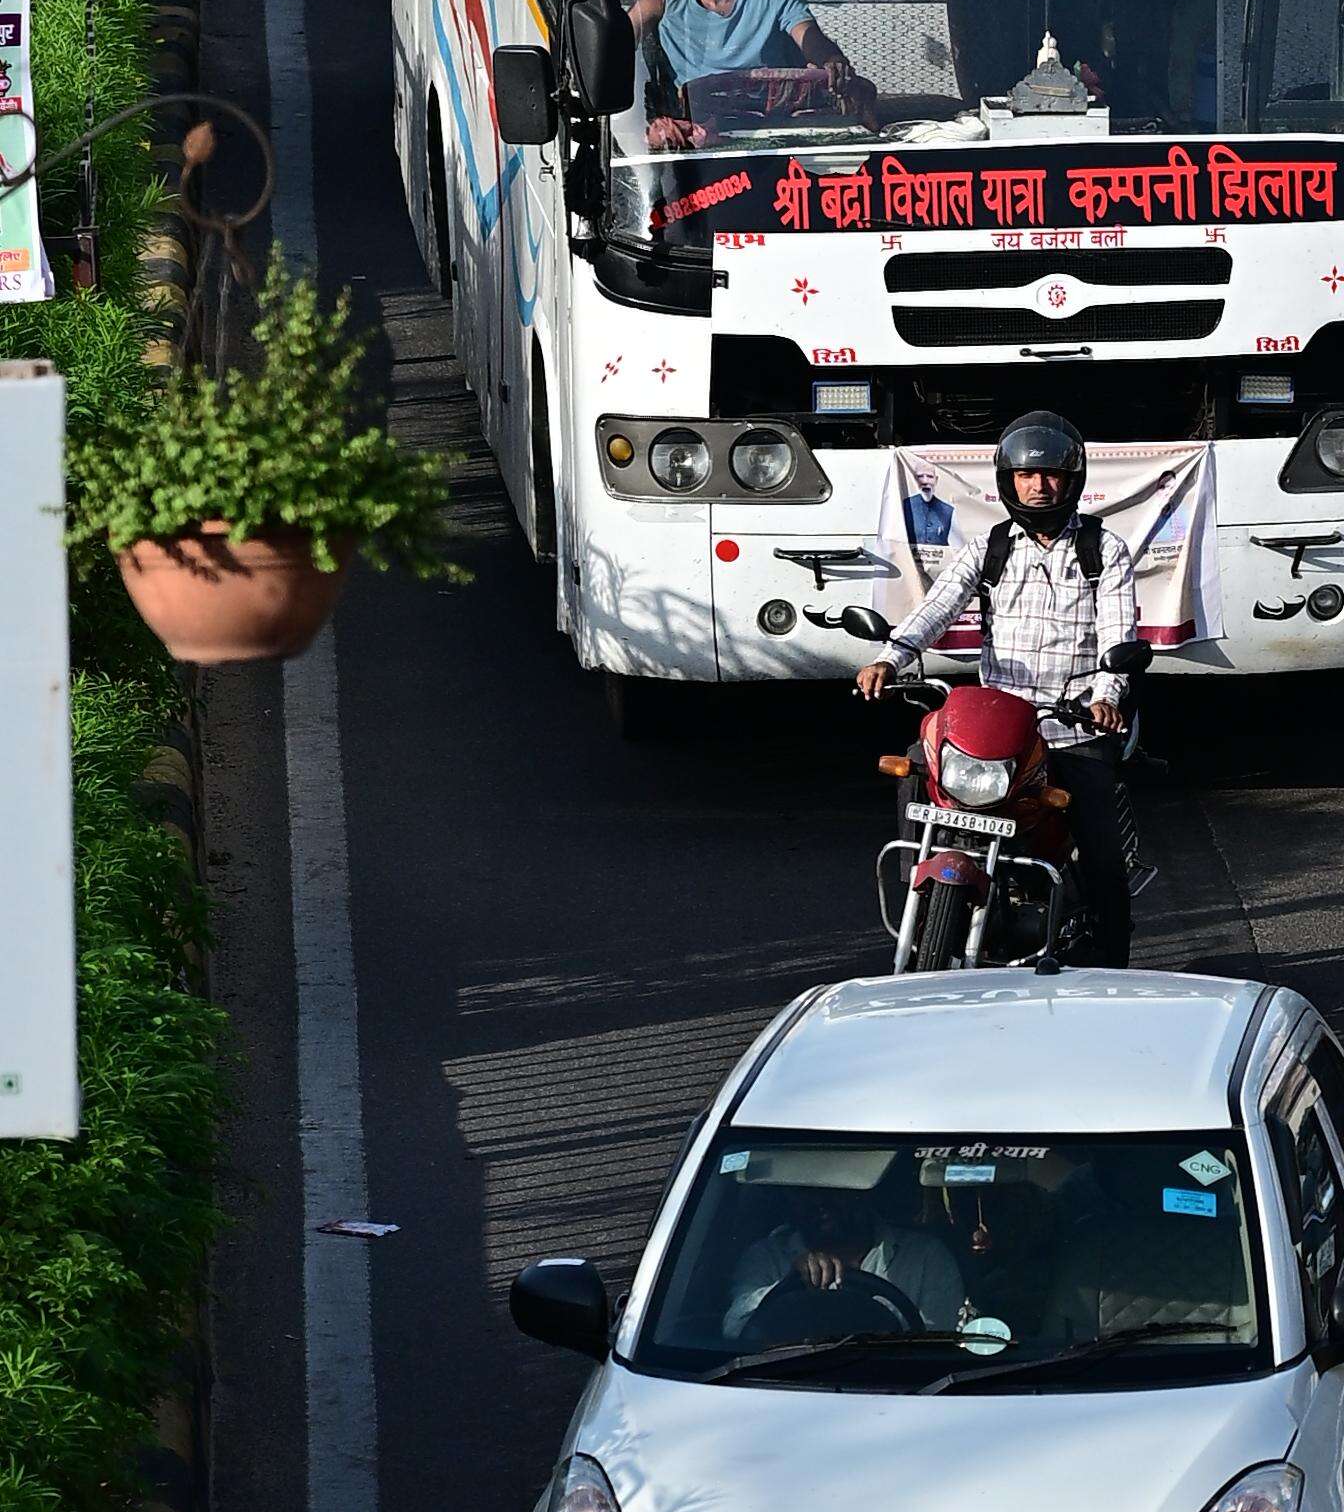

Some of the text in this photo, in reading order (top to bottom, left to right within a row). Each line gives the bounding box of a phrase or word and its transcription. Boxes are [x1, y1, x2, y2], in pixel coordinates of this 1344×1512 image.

[772, 155, 811, 230] श्री
[881, 155, 973, 227] विशाल
[980, 168, 1047, 225] यात्रा
[1066, 144, 1199, 224] कम्पनी
[1206, 143, 1338, 219] झिलाय
[715, 233, 766, 250] शुभ
[990, 231, 1024, 250] जय
[914, 1142, 1051, 1160] जय श्री श्याम
[1188, 1161, 1221, 1175] CNG
